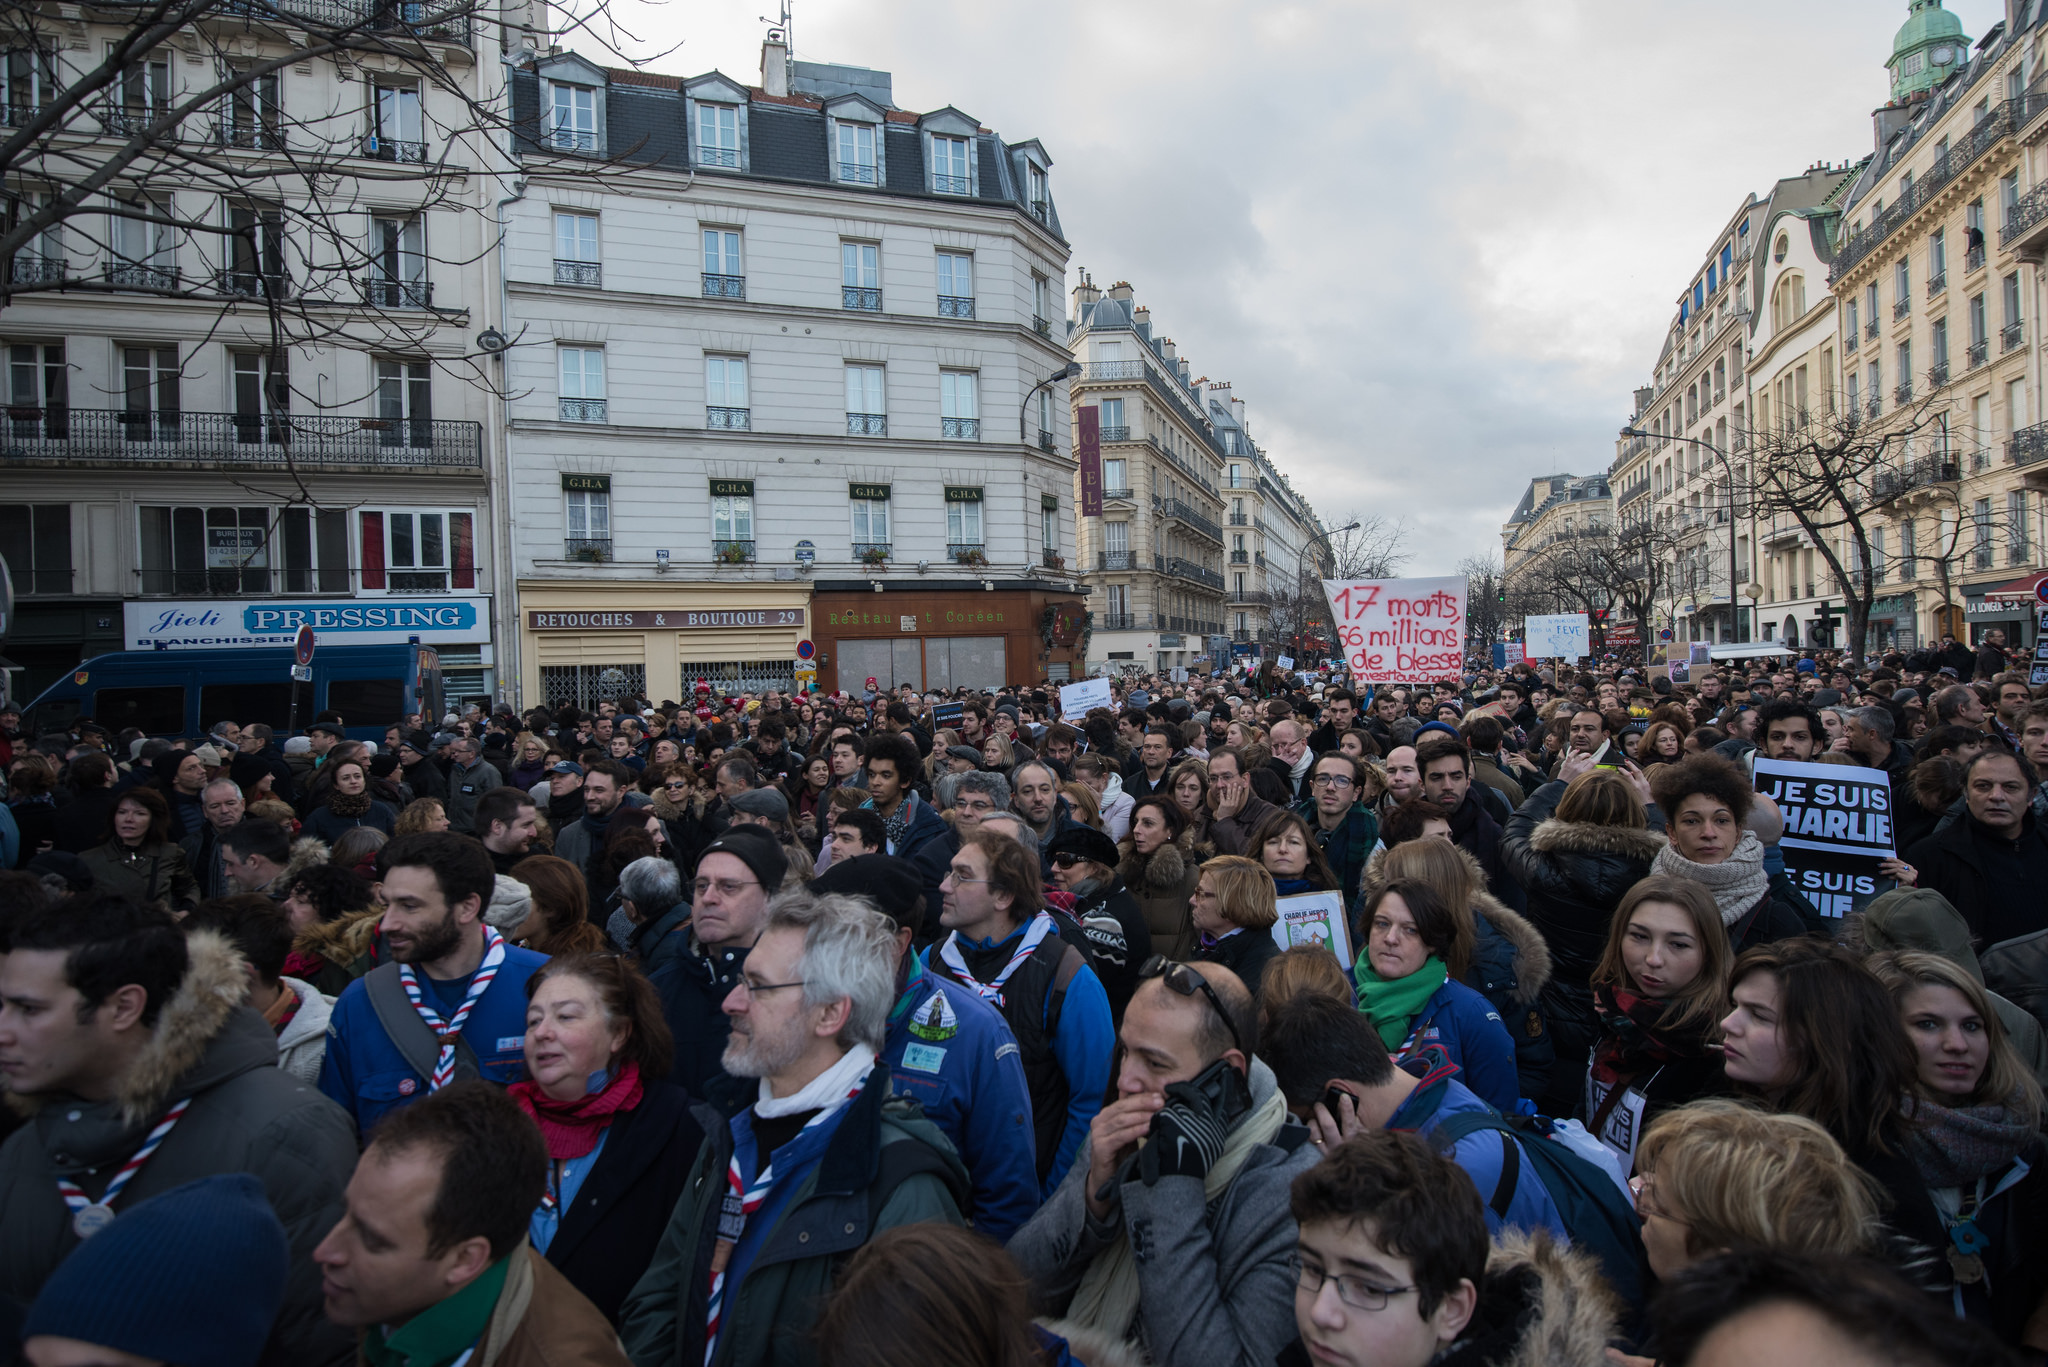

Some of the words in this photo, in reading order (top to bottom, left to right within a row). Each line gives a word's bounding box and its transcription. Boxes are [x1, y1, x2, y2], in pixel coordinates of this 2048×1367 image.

[1081, 410, 1097, 505] HOTEL
[569, 477, 602, 489] G.H.A
[716, 482, 747, 493] G.H.A
[855, 487, 885, 497] G.H.A
[950, 490, 978, 499] G.H.A
[1334, 585, 1381, 620] 17
[1967, 603, 1977, 613] LA
[1978, 601, 2003, 613] LONGUE
[149, 608, 225, 634] Jieli
[253, 607, 462, 630] PRESSING
[537, 613, 633, 627] RETOUCHES
[655, 613, 667, 626] &
[688, 612, 766, 625] BOUTIQUE
[778, 611, 796, 624] 29
[1369, 618, 1458, 647] millions
[1352, 648, 1384, 670] de
[1761, 780, 1807, 803] JE
[1813, 783, 1888, 811] SUIS
[1778, 804, 1892, 845] HARLIE
[1784, 868, 1797, 886] E
[1802, 869, 1876, 895] SUIS
